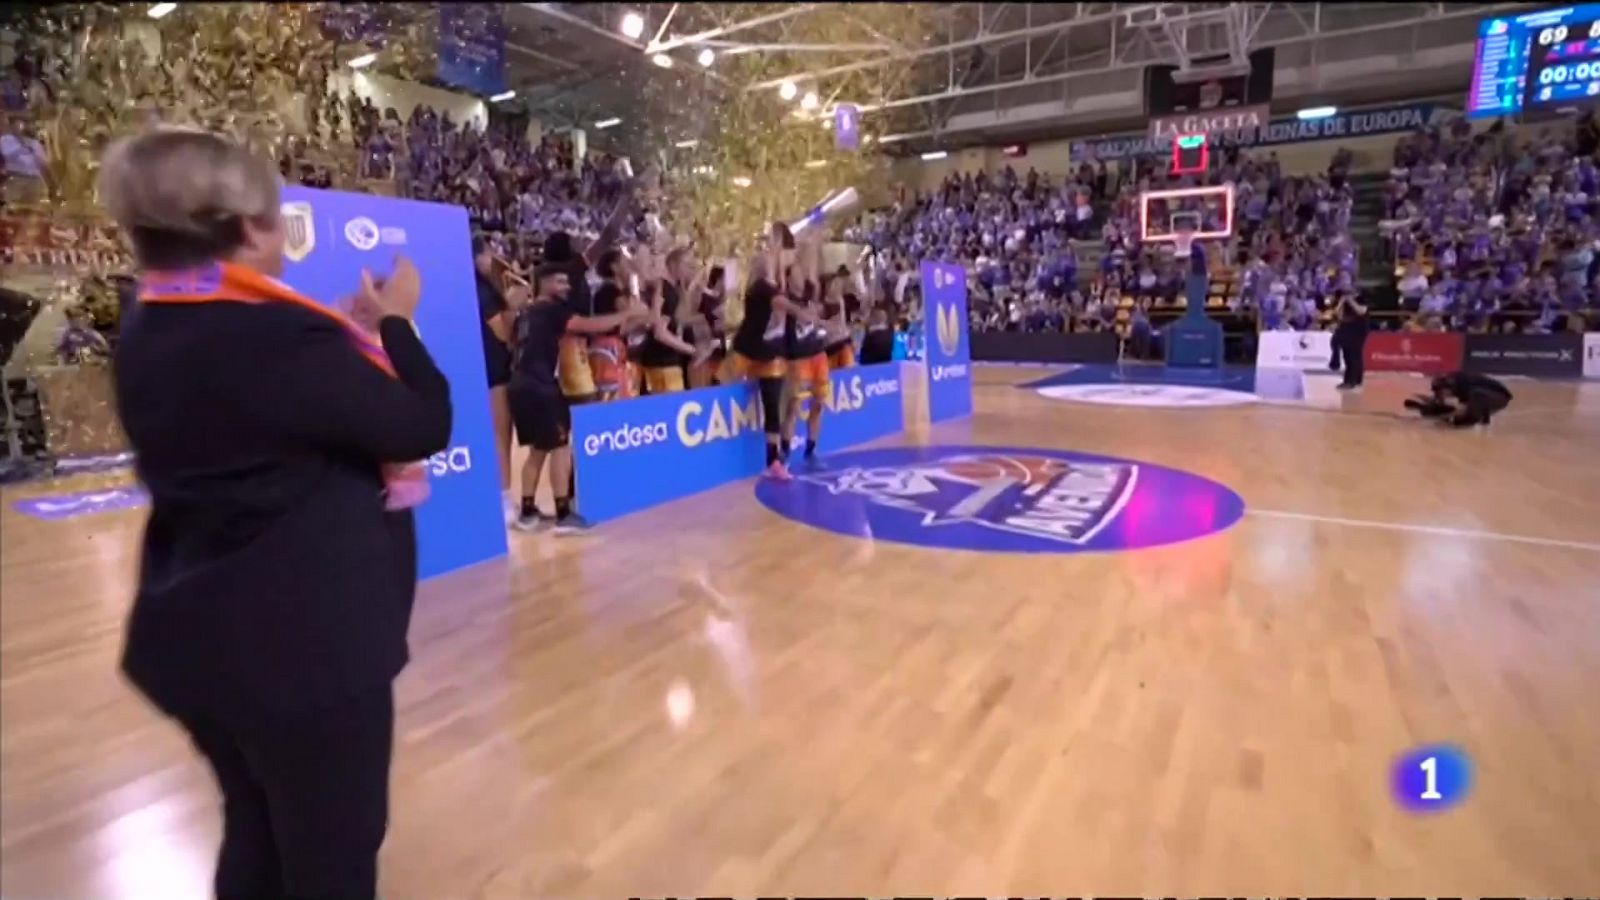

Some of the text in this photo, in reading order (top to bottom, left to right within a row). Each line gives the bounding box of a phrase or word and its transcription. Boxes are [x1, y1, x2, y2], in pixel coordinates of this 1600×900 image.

[1323, 116, 1346, 137] DE
[1350, 107, 1423, 132] EUROPA
[584, 421, 668, 456] endesa
